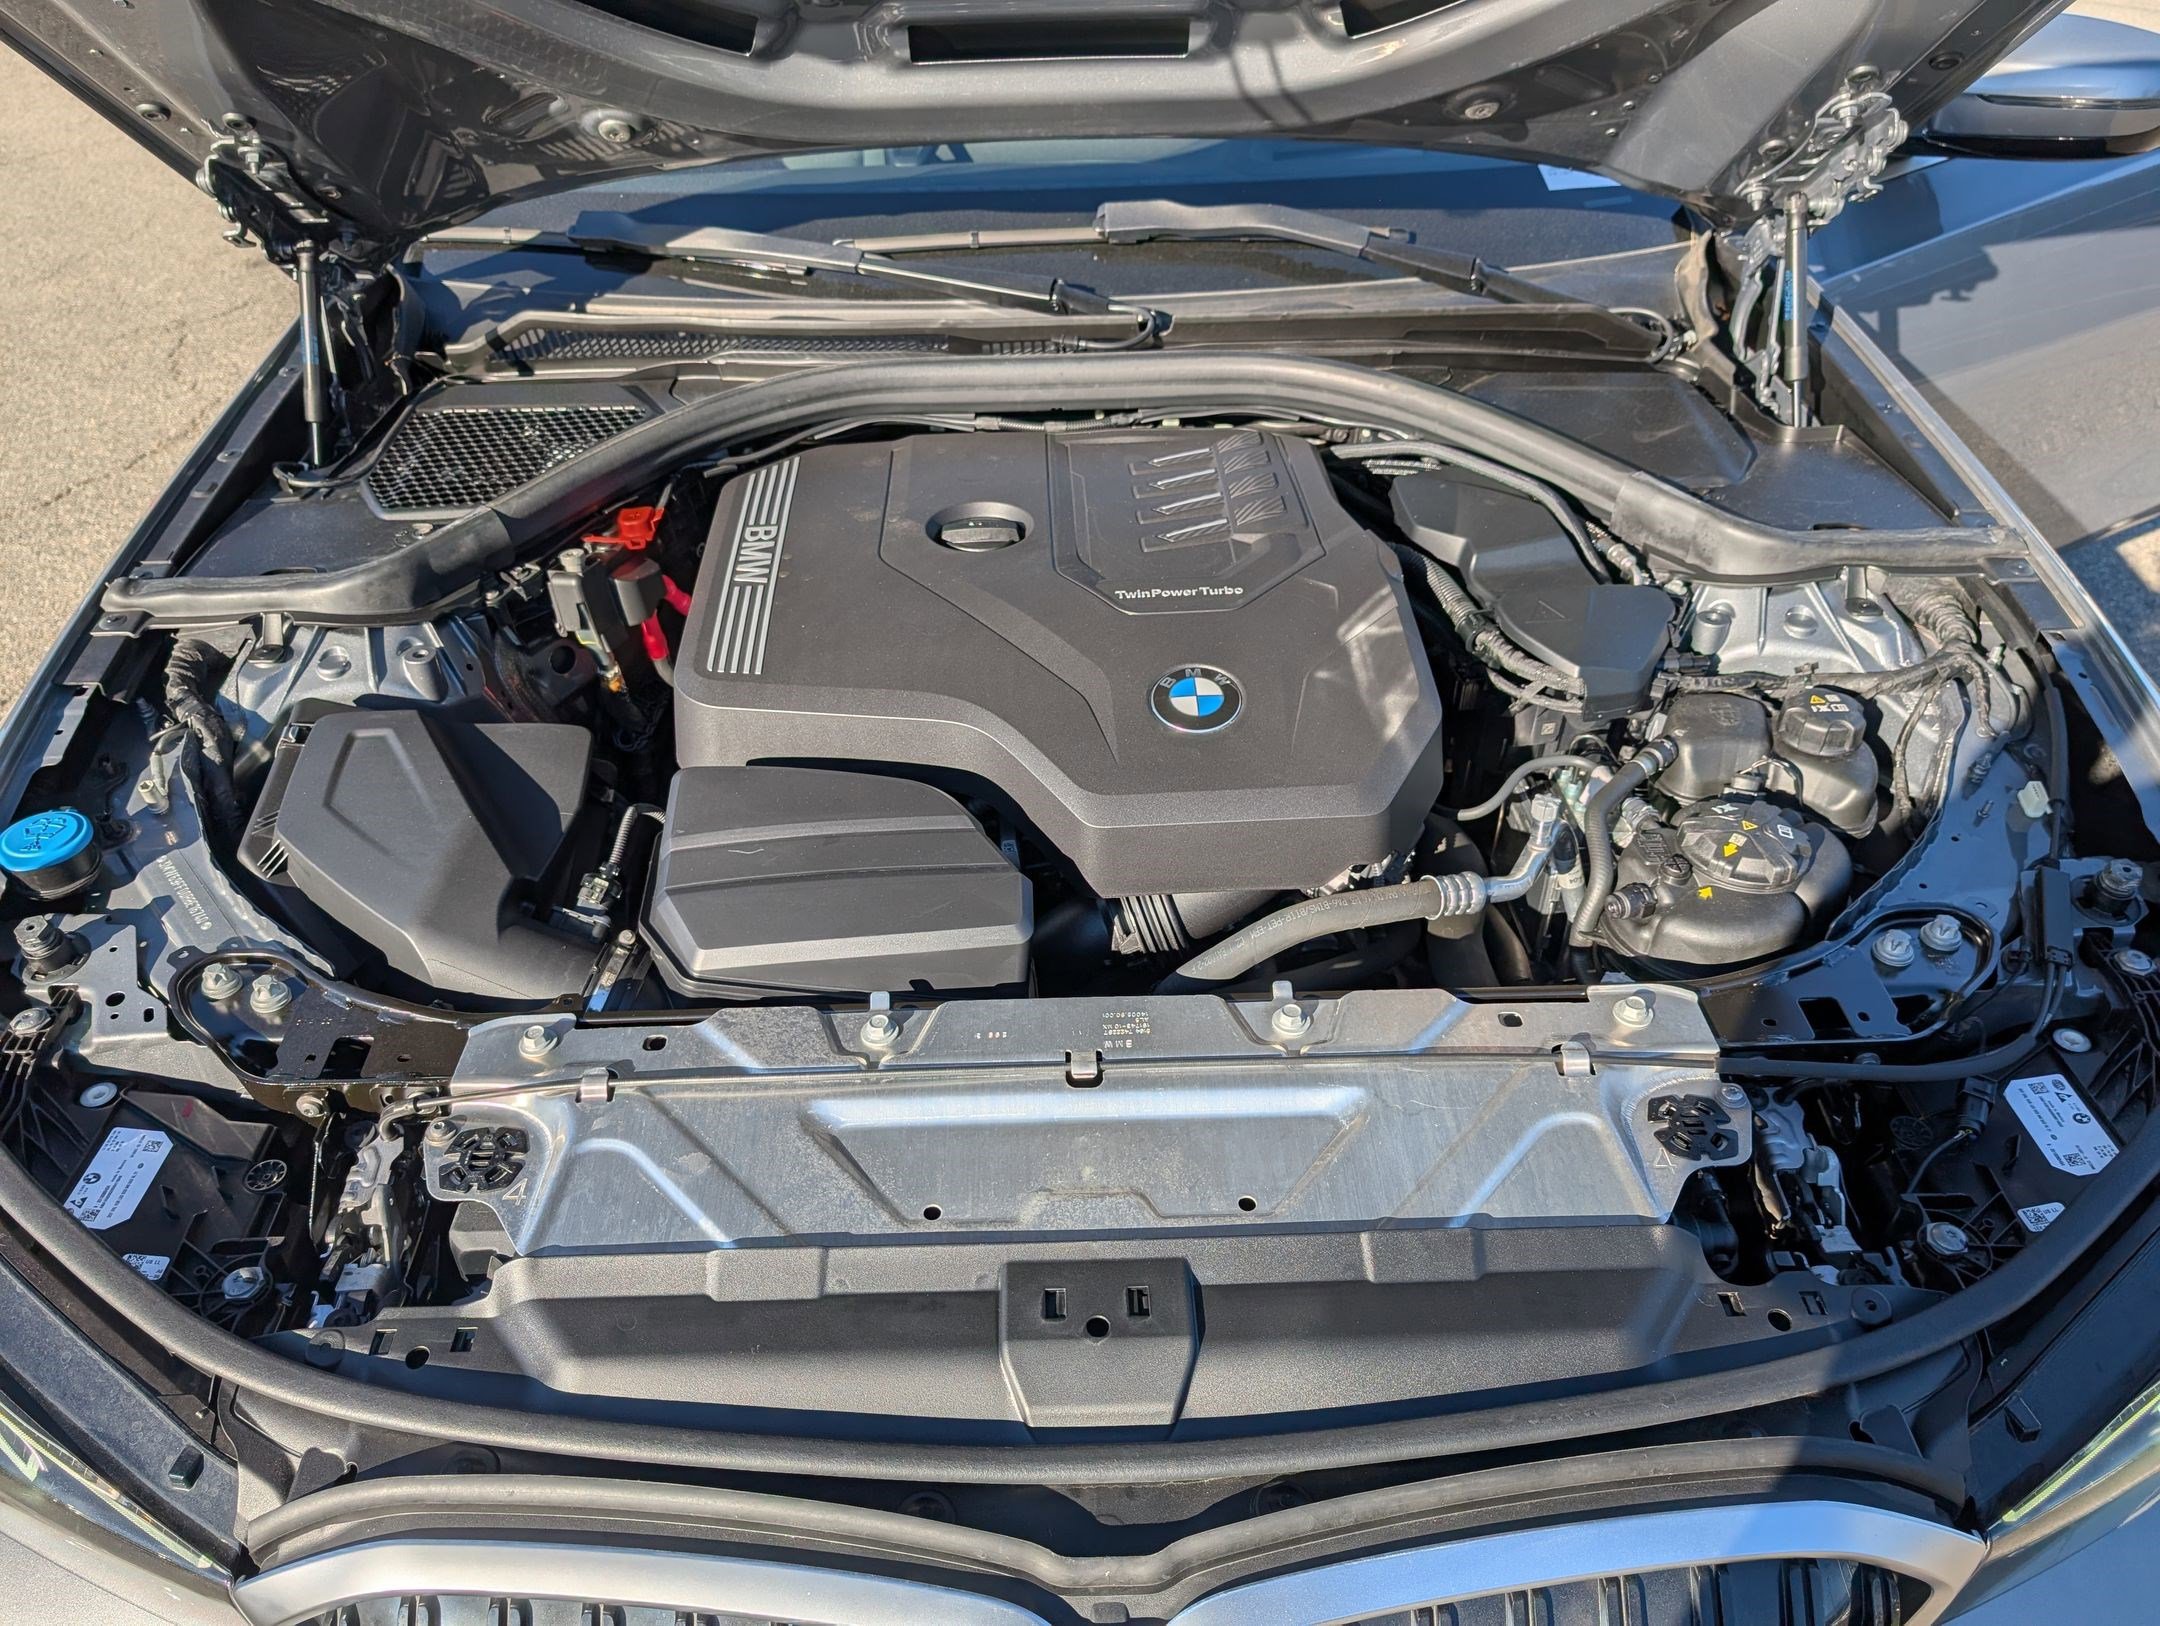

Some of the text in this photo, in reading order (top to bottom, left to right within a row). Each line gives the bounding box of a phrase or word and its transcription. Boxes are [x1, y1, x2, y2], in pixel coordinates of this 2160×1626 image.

[734, 526, 778, 584] BMW
[1115, 586, 1244, 600] TwinPower Turbo
[1160, 668, 1231, 689] BMW
[502, 1178, 528, 1206] 4
